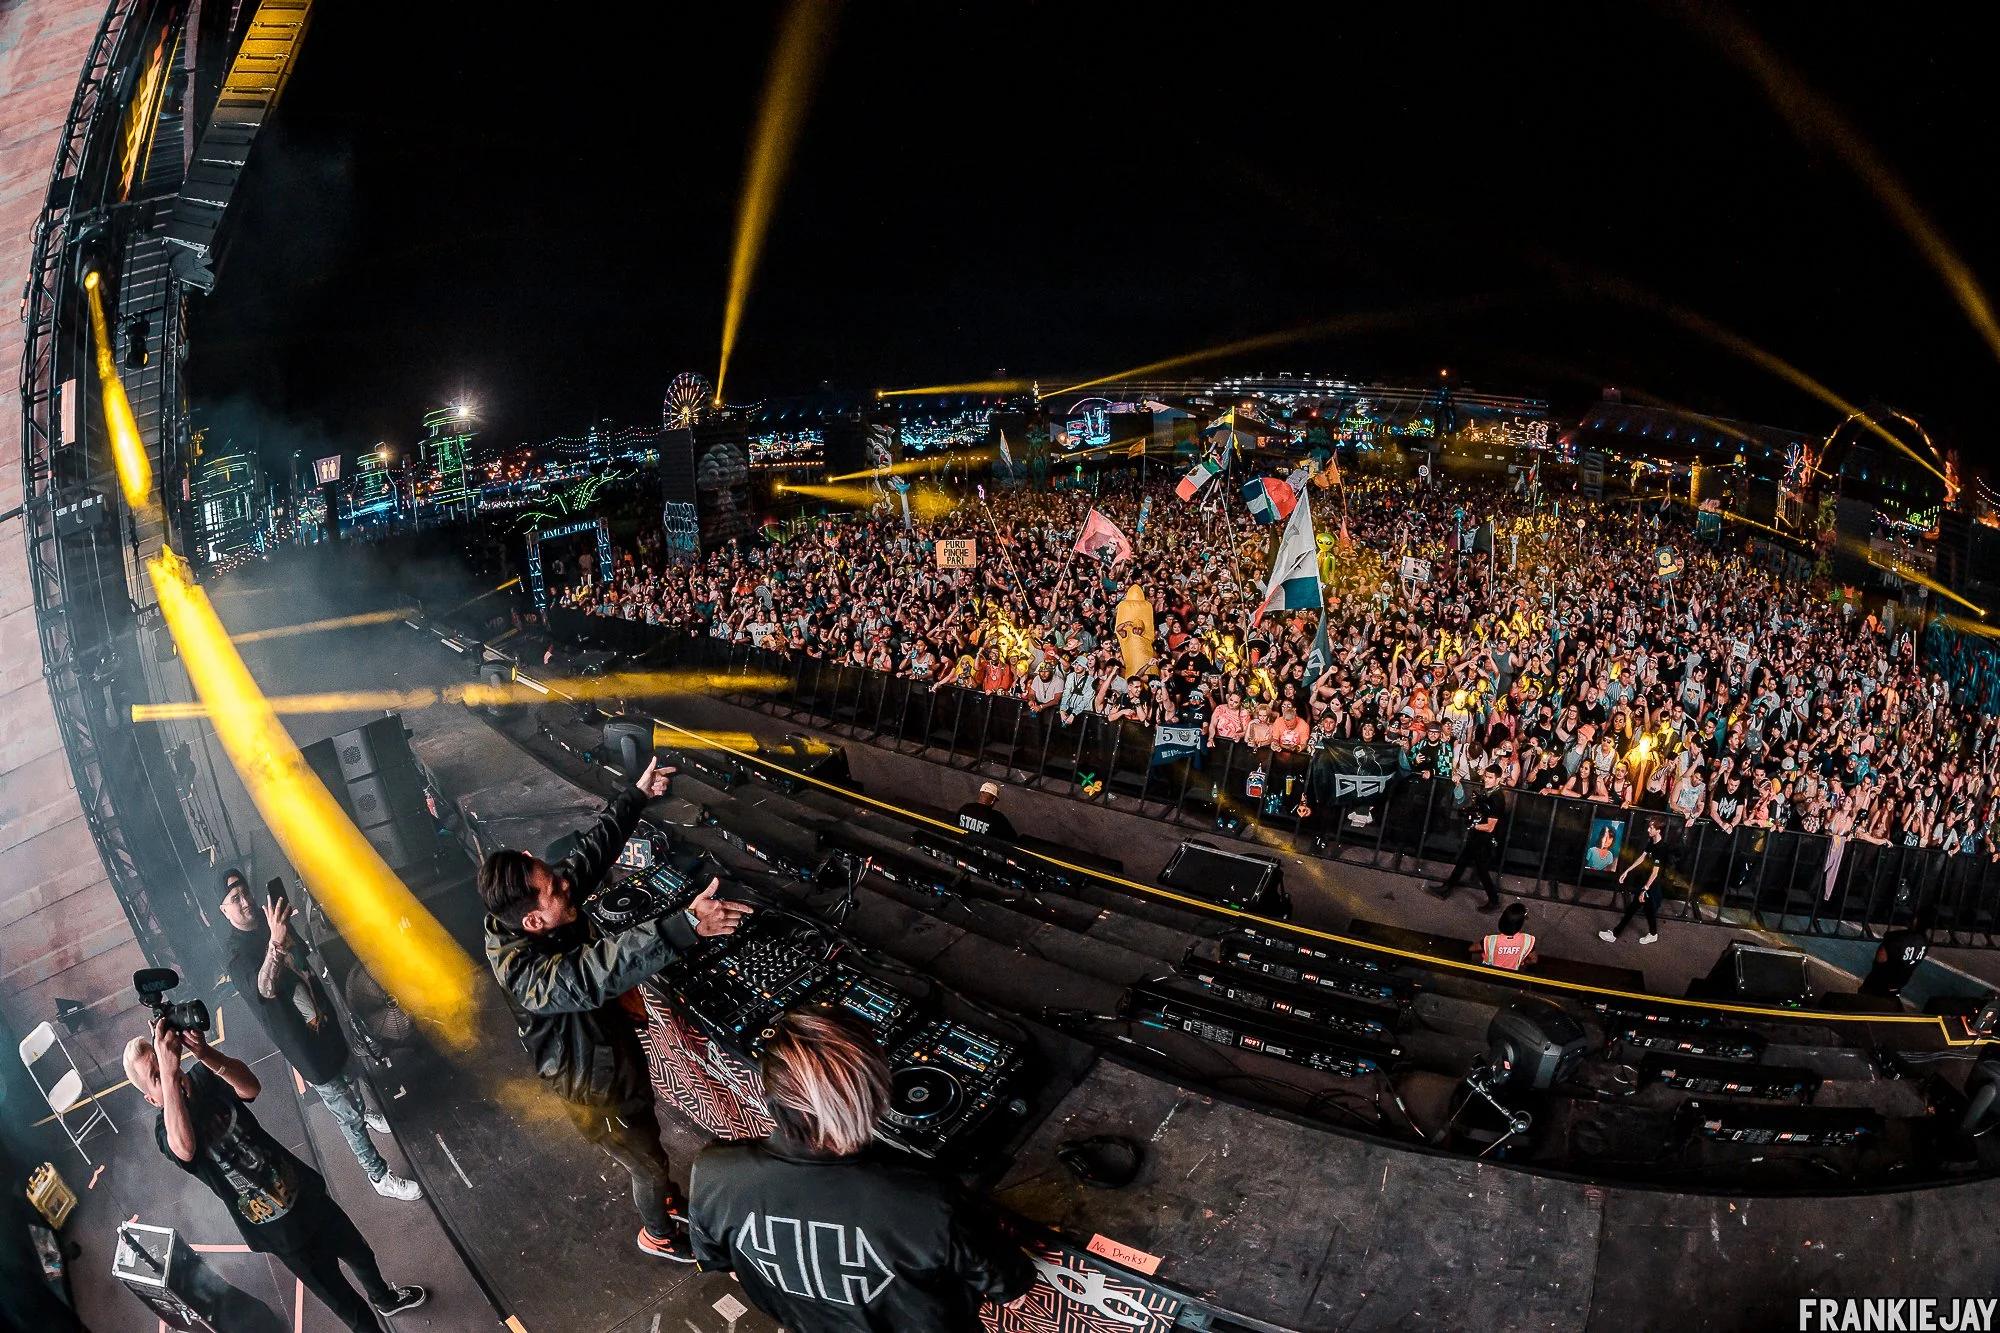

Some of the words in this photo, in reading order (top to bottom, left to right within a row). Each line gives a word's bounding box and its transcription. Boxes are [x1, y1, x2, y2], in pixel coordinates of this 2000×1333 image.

[945, 540, 966, 548] PURO
[943, 548, 969, 557] PINCHE
[946, 556, 965, 565] PARI
[484, 616, 504, 629] VIP
[524, 613, 537, 623] VIP
[959, 814, 990, 835] STAFF
[1497, 946, 1521, 955] STAFF
[1091, 1241, 1106, 1253] No
[1112, 1247, 1148, 1265] Drinks!
